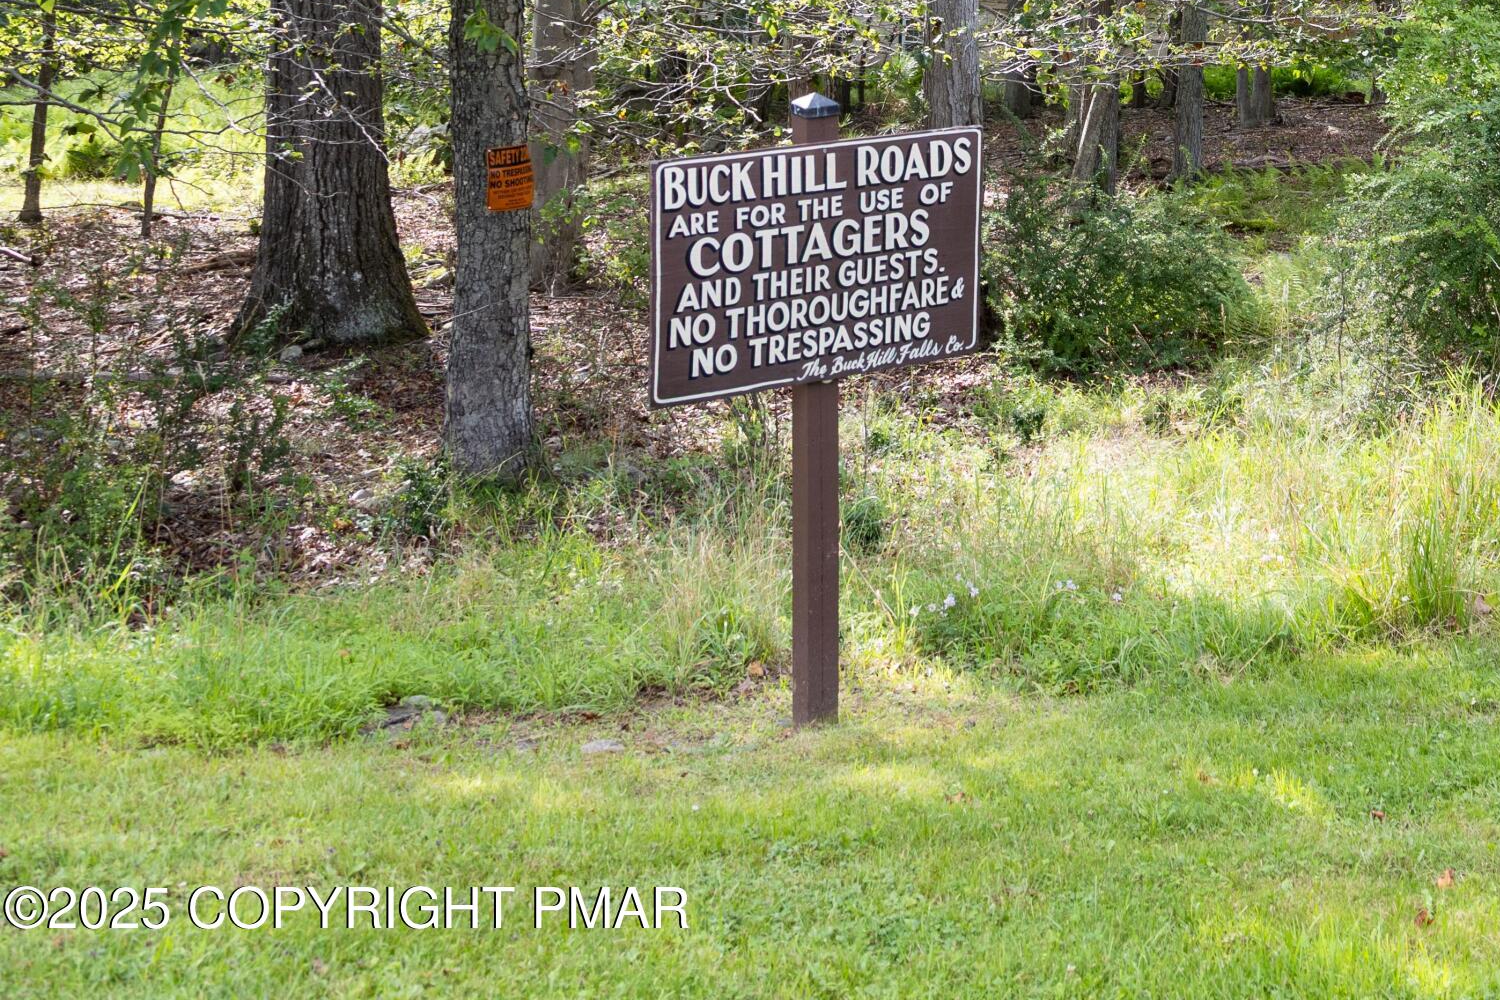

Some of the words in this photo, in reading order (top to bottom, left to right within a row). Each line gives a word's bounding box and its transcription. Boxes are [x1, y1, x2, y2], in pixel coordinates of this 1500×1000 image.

[489, 149, 520, 166] SAFETY
[490, 170, 501, 178] NO
[505, 176, 533, 188] SHOOT
[664, 163, 756, 210] BUCK
[763, 153, 847, 198] HILL
[857, 138, 971, 187] ROADS
[669, 211, 719, 238] ARE
[736, 203, 785, 230] FOR
[798, 196, 843, 222] THE
[860, 188, 904, 214] USE
[920, 182, 953, 205] OF
[689, 209, 930, 277] COTTAGERS
[677, 277, 741, 312] AND
[753, 265, 830, 301] THEIR
[839, 248, 945, 288] GUESTS.
[670, 315, 716, 348] NO
[726, 277, 949, 339] THOROUGHFARE
[951, 278, 964, 300] &
[692, 345, 737, 378] NO
[749, 312, 930, 367] TRESPASSING
[797, 359, 828, 380] The
[831, 353, 865, 375] Buck
[863, 347, 897, 372] Hill
[896, 339, 942, 365] Falls
[946, 335, 964, 355] Co.
